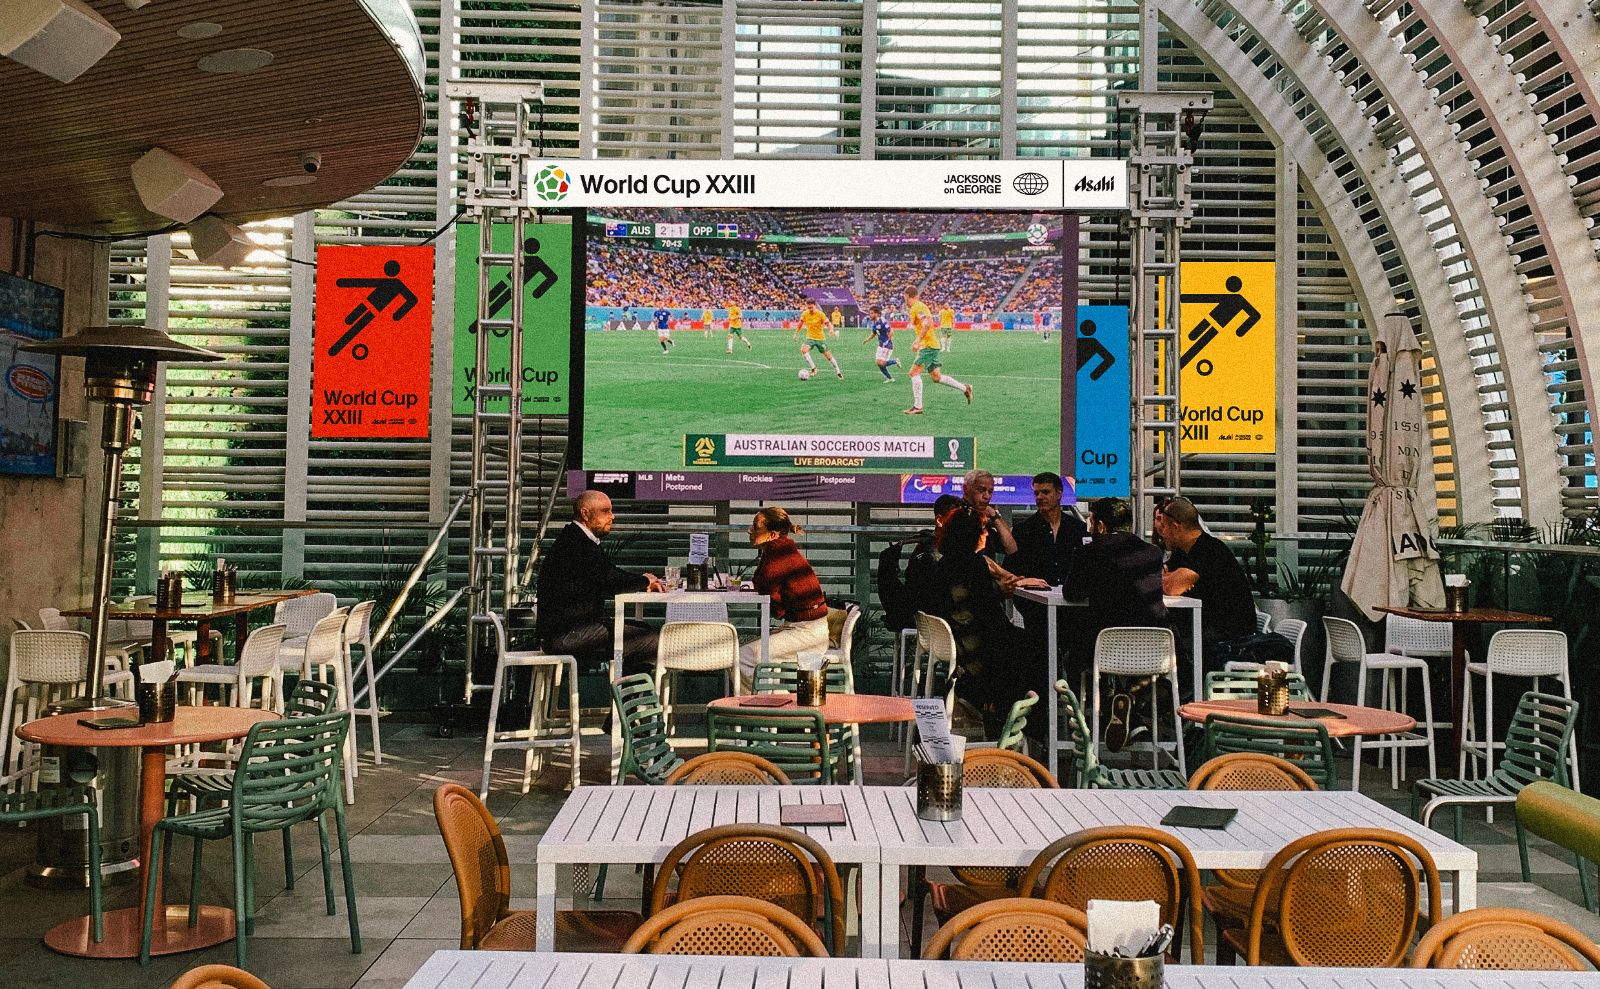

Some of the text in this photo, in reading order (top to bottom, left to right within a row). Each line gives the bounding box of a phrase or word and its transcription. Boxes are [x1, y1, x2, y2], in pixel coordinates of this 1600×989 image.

[580, 174, 755, 198] World Cup XXIII
[944, 174, 1001, 184] JACKSONS
[1074, 175, 1115, 192] Asahi
[944, 185, 1001, 194] on GEORGE
[630, 226, 651, 235] AUS
[660, 226, 667, 235] 2
[692, 226, 714, 235] OPP
[522, 367, 558, 386] Cup
[324, 390, 418, 409] World Cup
[323, 410, 362, 424] XXIII
[1227, 406, 1263, 424] Cup
[734, 439, 925, 453] AUSTRALIAN SOCCEROOS MATCH
[794, 457, 865, 467] LIVE BROARCAST
[1081, 450, 1118, 469] Cup
[593, 473, 629, 483] ESPN
[665, 483, 702, 491] Postponed
